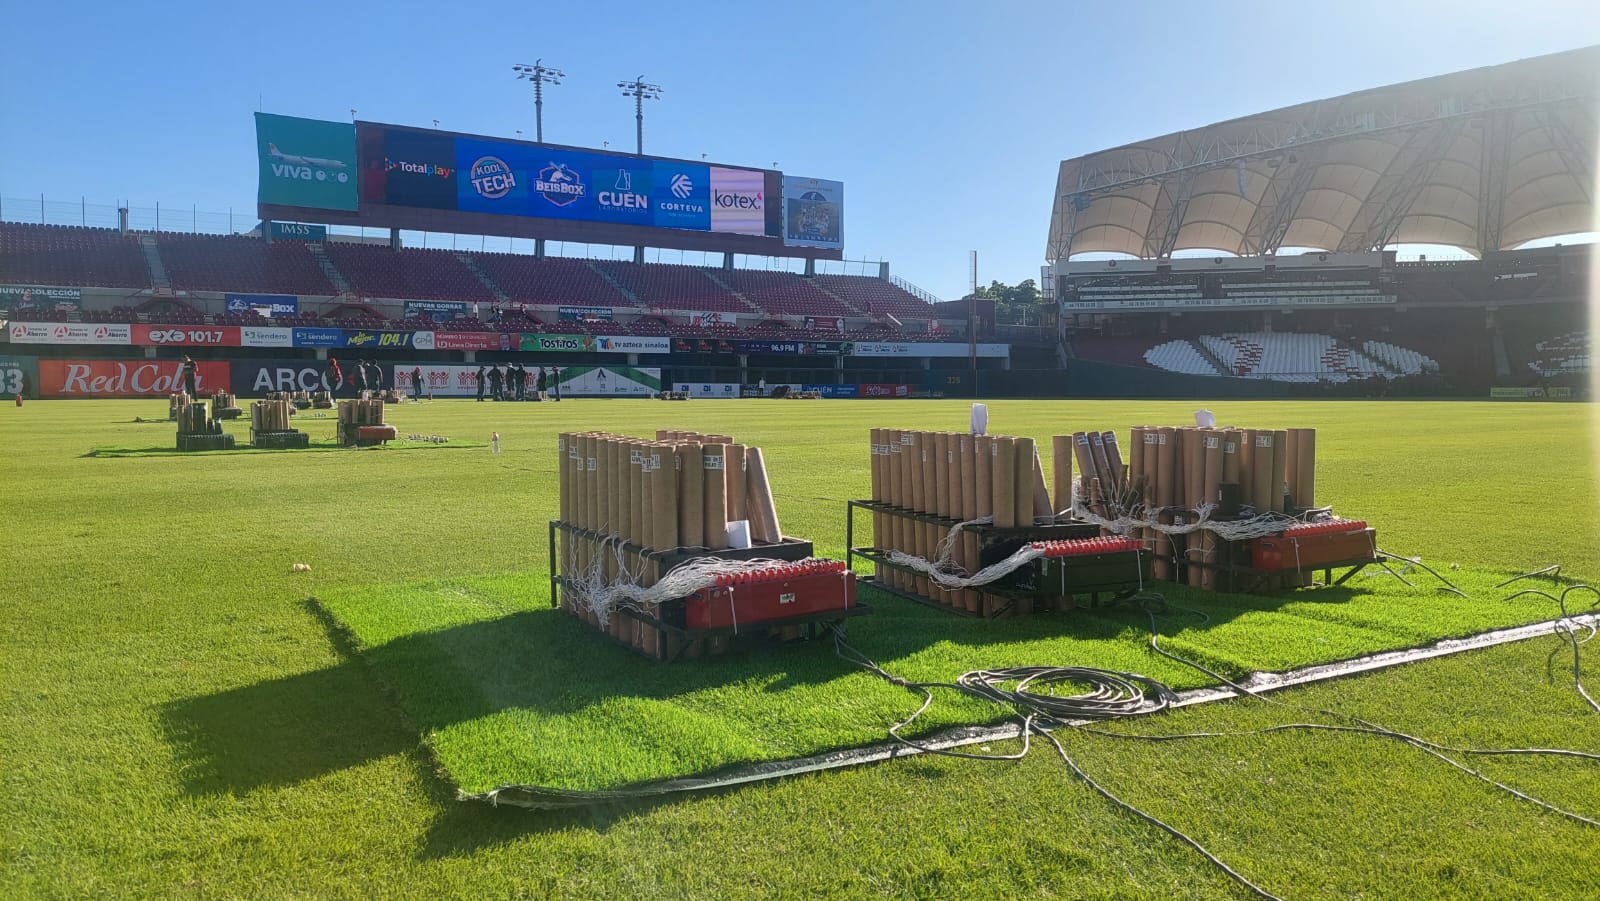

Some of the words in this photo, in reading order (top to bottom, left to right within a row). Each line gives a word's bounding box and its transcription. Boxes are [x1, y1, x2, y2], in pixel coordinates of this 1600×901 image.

[400, 161, 450, 179] Totalplay
[476, 163, 502, 176] KOOL
[472, 173, 516, 194] TECH
[598, 191, 648, 209] CUÉN
[660, 202, 703, 213] CORTEVA
[281, 223, 310, 235] IMSS
[187, 330, 224, 343] 101.7
[378, 333, 410, 346] 104.1
[59, 362, 127, 392] Red
